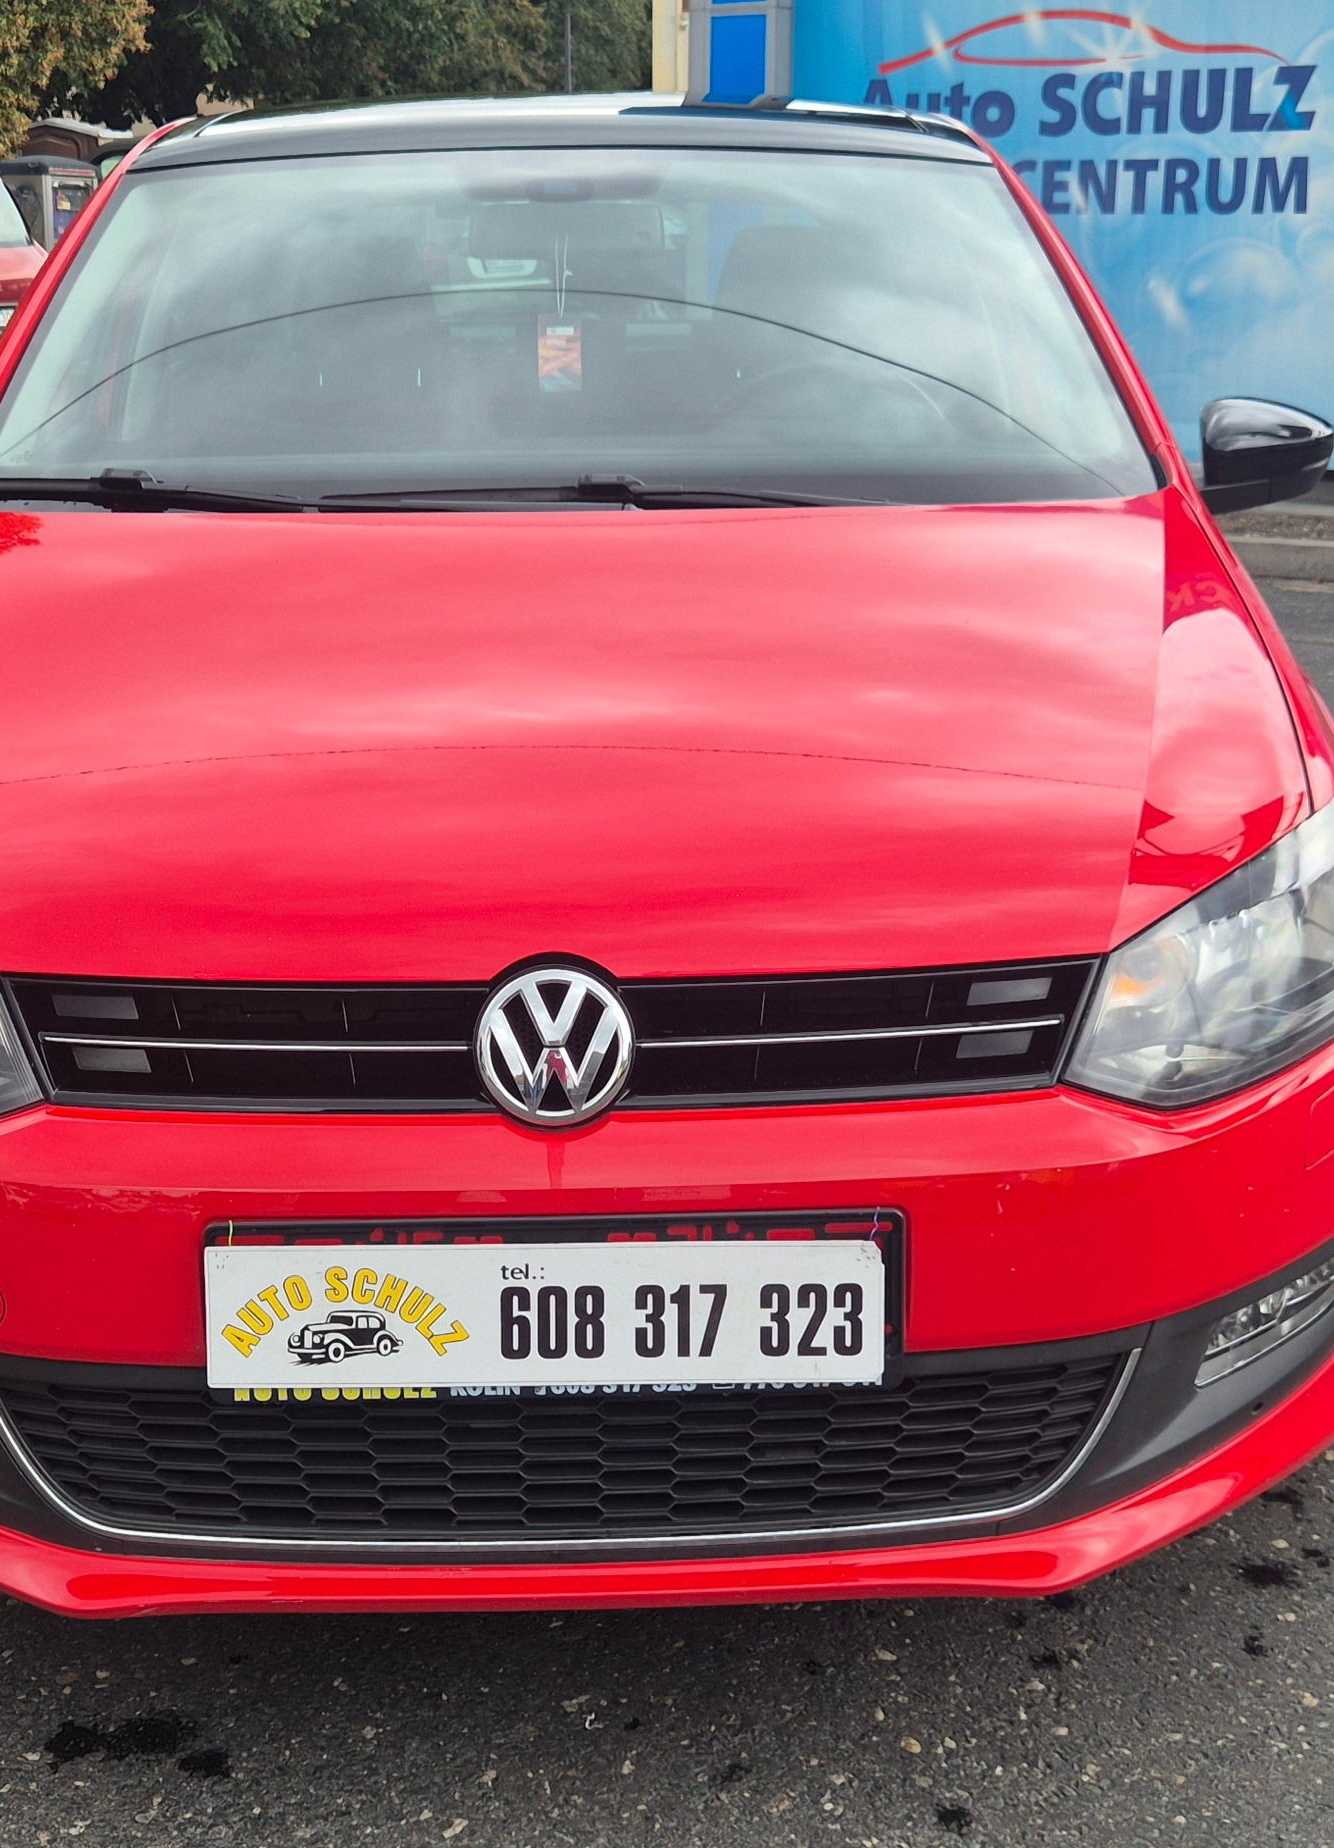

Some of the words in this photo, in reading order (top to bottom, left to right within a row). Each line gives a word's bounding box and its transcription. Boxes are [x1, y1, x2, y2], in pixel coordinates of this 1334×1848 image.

[1040, 65, 1318, 137] SCHULZ
[500, 1263, 545, 1280] tel.:
[221, 1275, 313, 1358] AUTO
[324, 1266, 470, 1357] SCHULZ
[500, 1286, 605, 1360] 608
[635, 1284, 727, 1357] 317
[760, 1283, 863, 1357] 323
